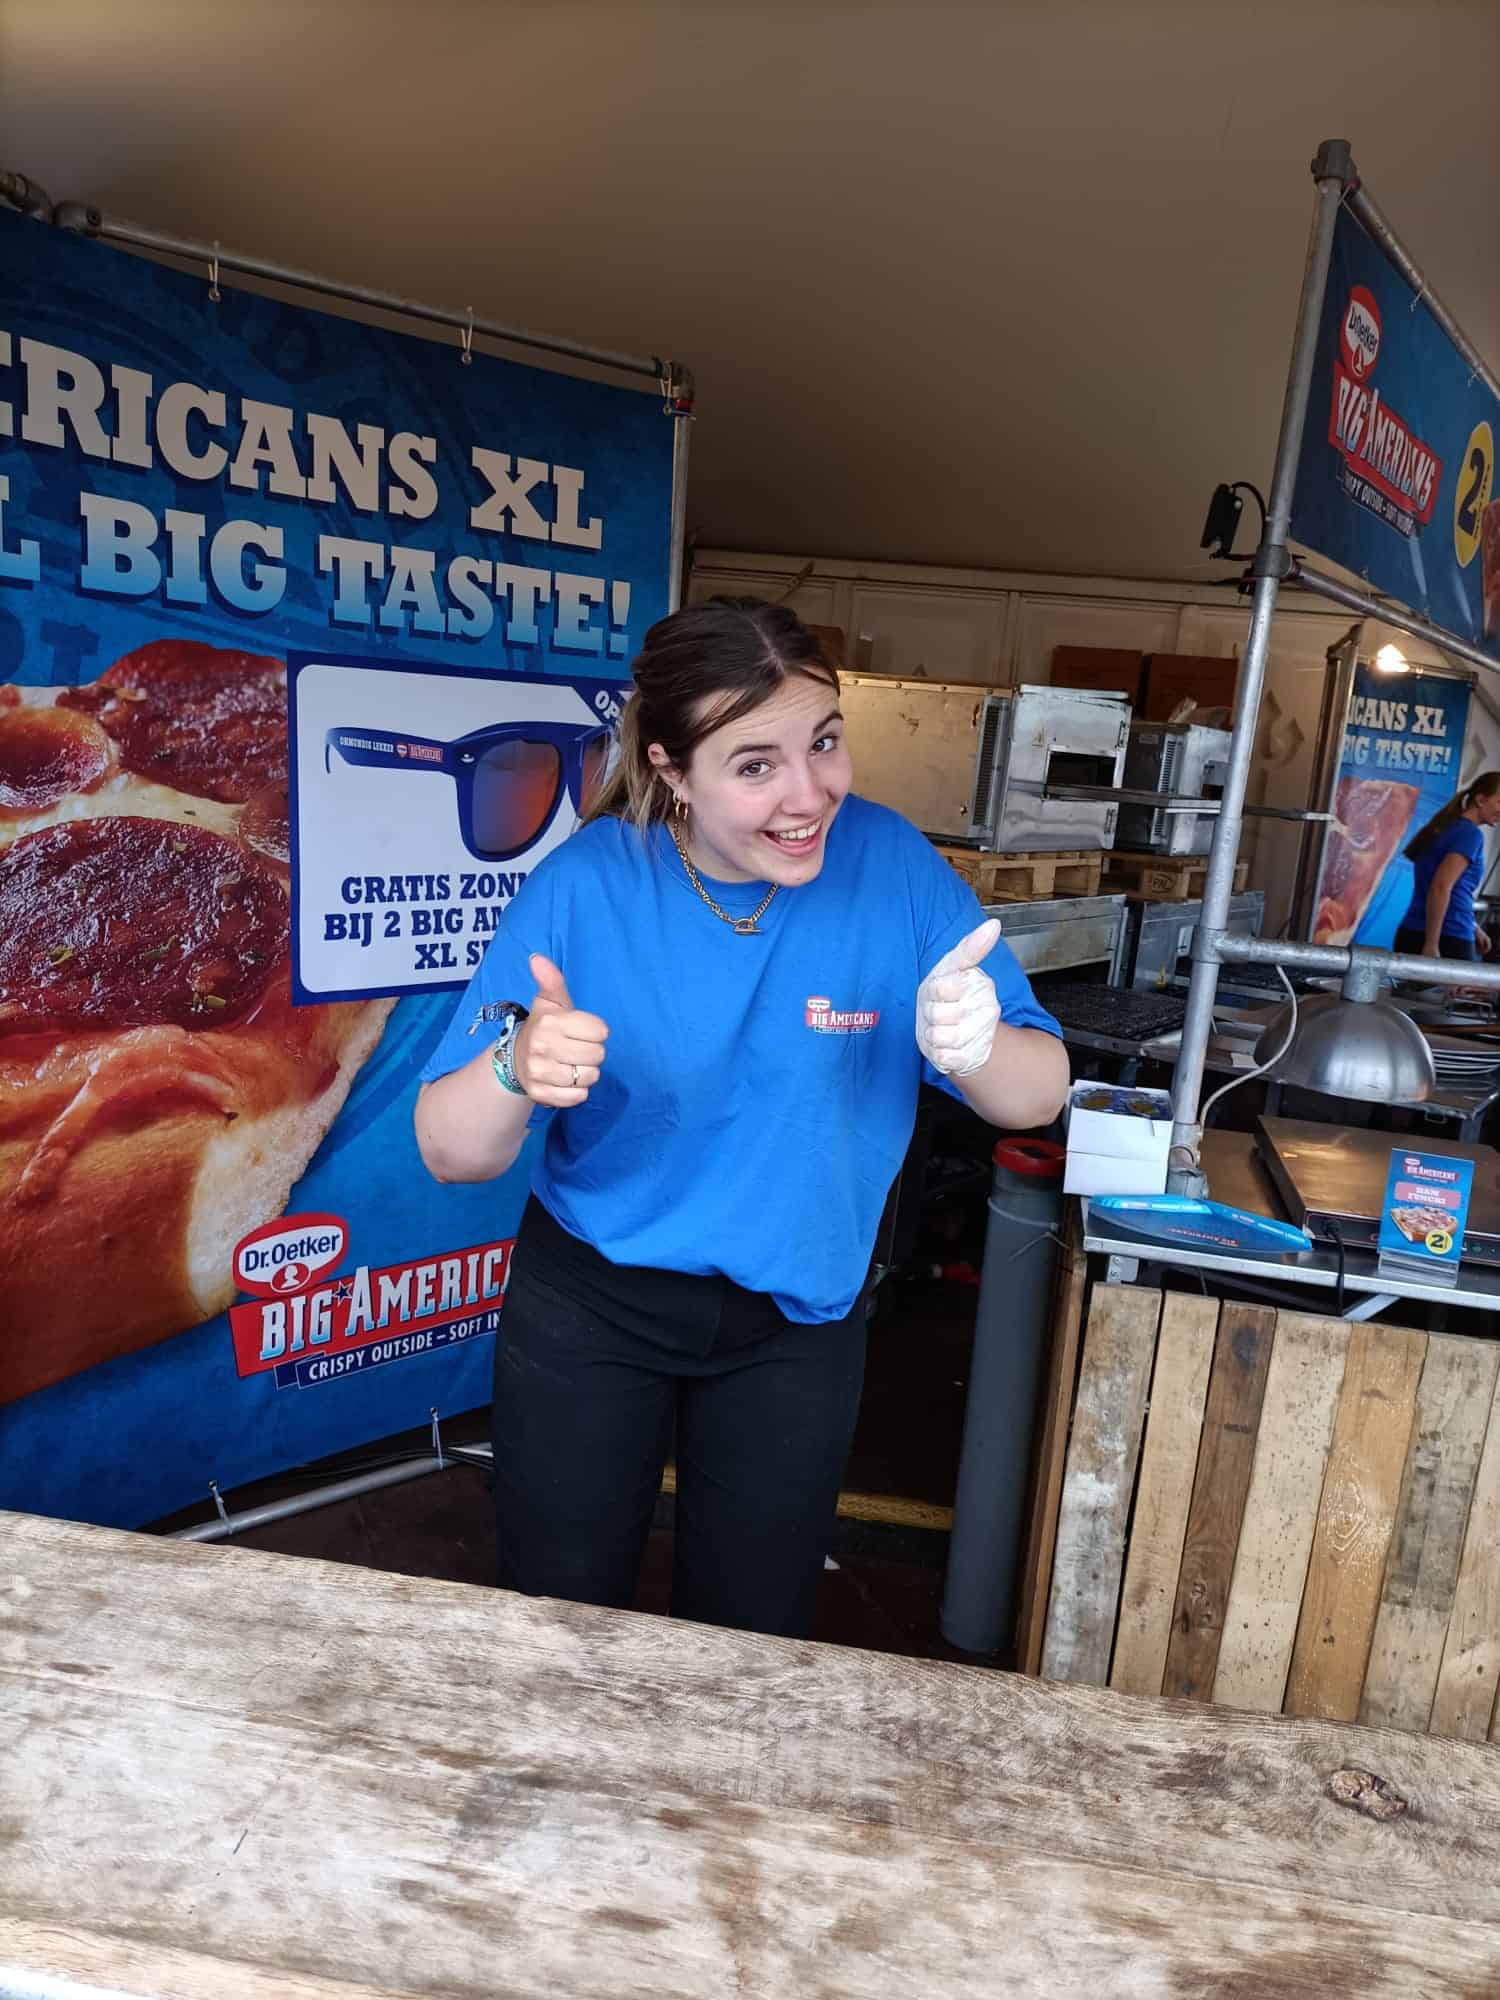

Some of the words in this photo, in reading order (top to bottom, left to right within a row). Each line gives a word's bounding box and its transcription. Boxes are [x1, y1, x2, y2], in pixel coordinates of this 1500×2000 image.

[0, 331, 438, 519] RICANS
[470, 446, 602, 549] XL
[1457, 447, 1485, 536] 2
[80, 491, 287, 613] BIG
[318, 534, 631, 654] TASTE!
[1411, 705, 1447, 737] XL
[1376, 738, 1451, 774] TASTE!
[341, 874, 450, 904] GRATIS
[324, 913, 373, 947] BIJ
[384, 911, 401, 938] 2
[411, 908, 463, 936] BIG
[414, 944, 457, 970] XL
[1430, 1234, 1444, 1249] 2
[259, 1292, 332, 1360] BIG
[308, 1351, 364, 1381] CRISPY
[371, 1330, 433, 1362] OUTSIDE
[449, 1317, 482, 1342] SOFT
